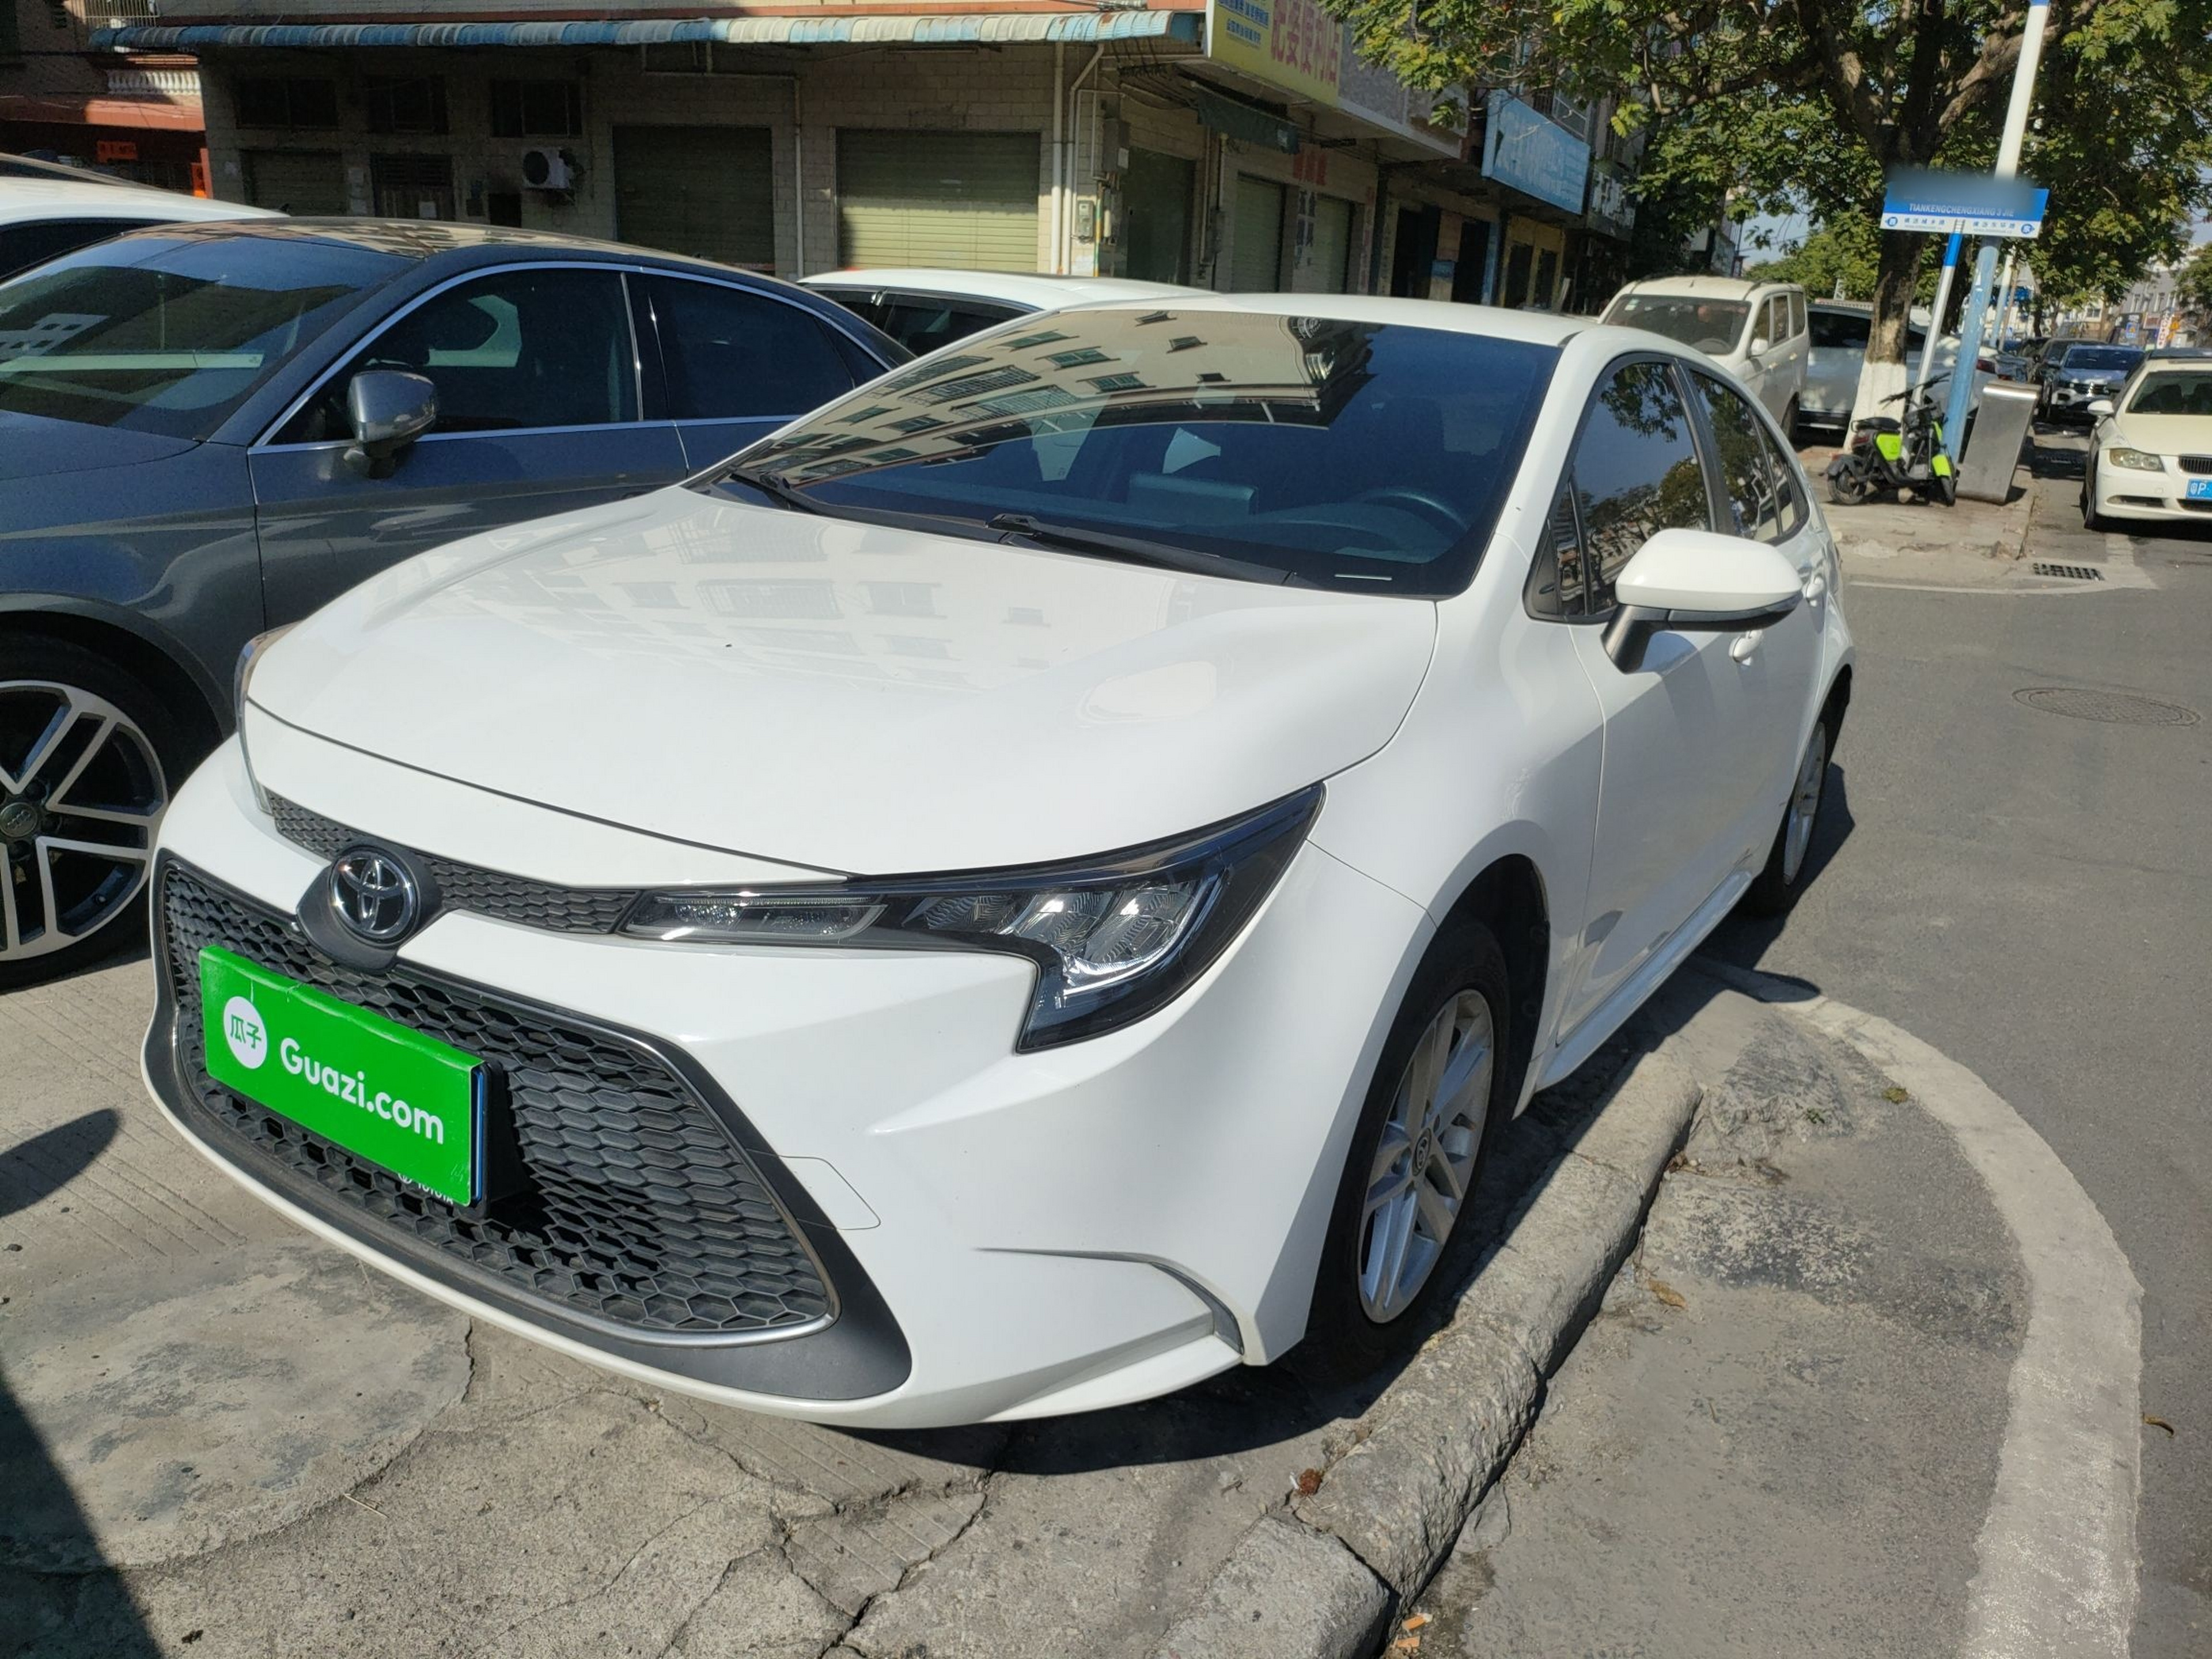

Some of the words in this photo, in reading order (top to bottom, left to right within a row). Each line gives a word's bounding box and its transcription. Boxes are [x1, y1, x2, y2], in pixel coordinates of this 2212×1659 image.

[1909, 203, 1995, 217] TIANKENGCHENGXIANG
[1996, 208, 2001, 217] 3
[2002, 208, 2015, 217] JIE
[230, 1014, 262, 1050] 瓜子
[280, 1037, 444, 1145] Guazi.com
